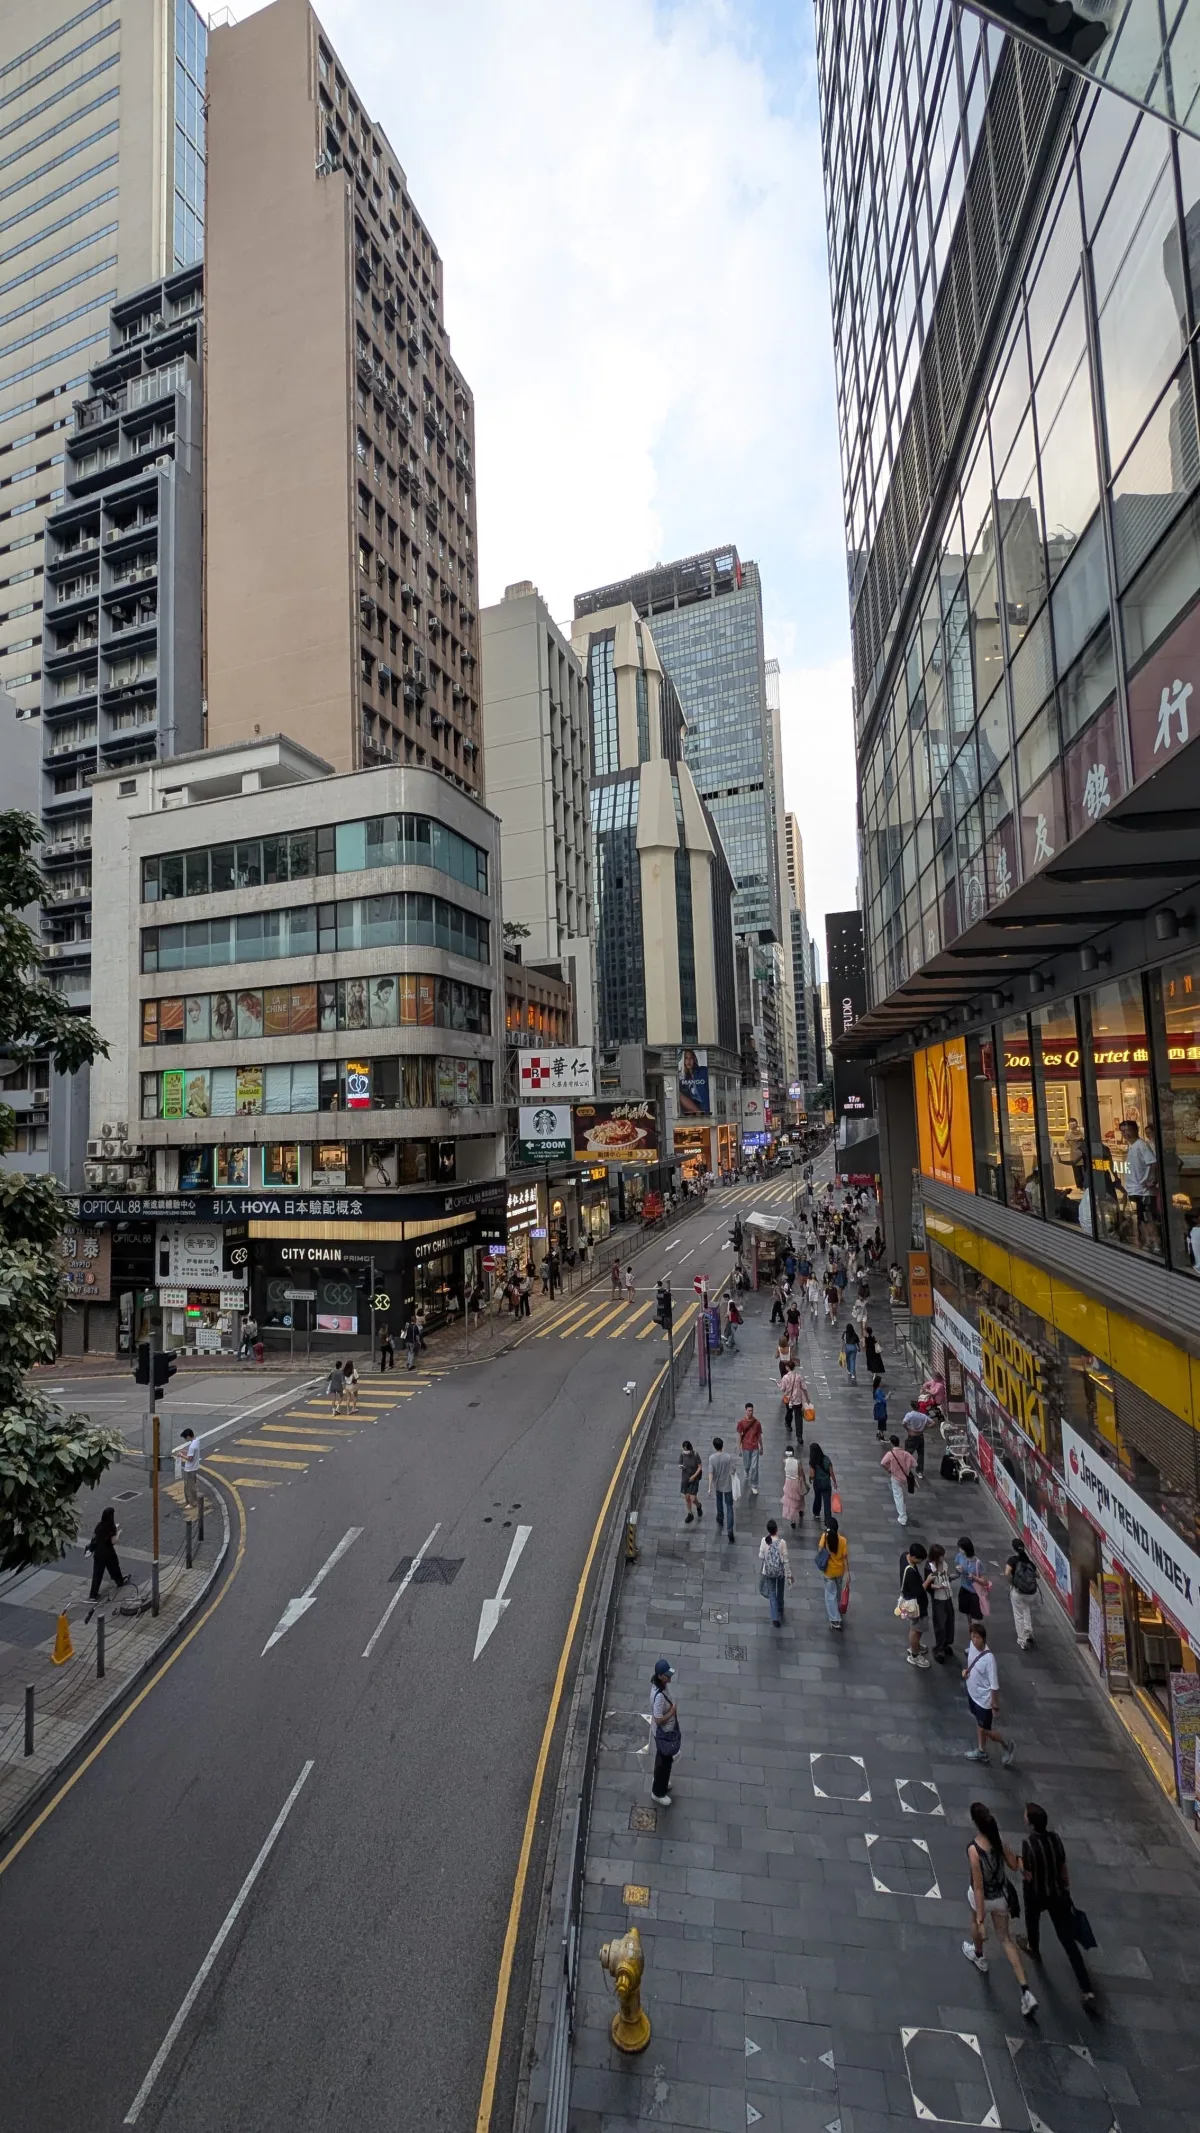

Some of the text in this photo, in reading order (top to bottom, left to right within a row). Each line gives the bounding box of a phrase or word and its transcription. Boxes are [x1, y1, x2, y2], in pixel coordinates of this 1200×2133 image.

[266, 1004, 287, 1013] CHINE
[1003, 1051, 1063, 1067] Cooes
[1065, 1050, 1131, 1068] Qartet
[551, 1056, 589, 1079] 華仁
[83, 1200, 141, 1214] OPTICAL 88
[213, 1200, 363, 1215] 引入 HOYA 日本驗配概念
[112, 1233, 152, 1244] OPTICAL 88
[281, 1248, 305, 1260] CITY
[307, 1248, 342, 1261] CHAIN
[415, 1242, 432, 1258] CITY
[432, 1236, 453, 1253] CHAIN
[982, 1341, 1047, 1456] DONKI
[1080, 1450, 1194, 1607] JAPAN TREND INDEX
